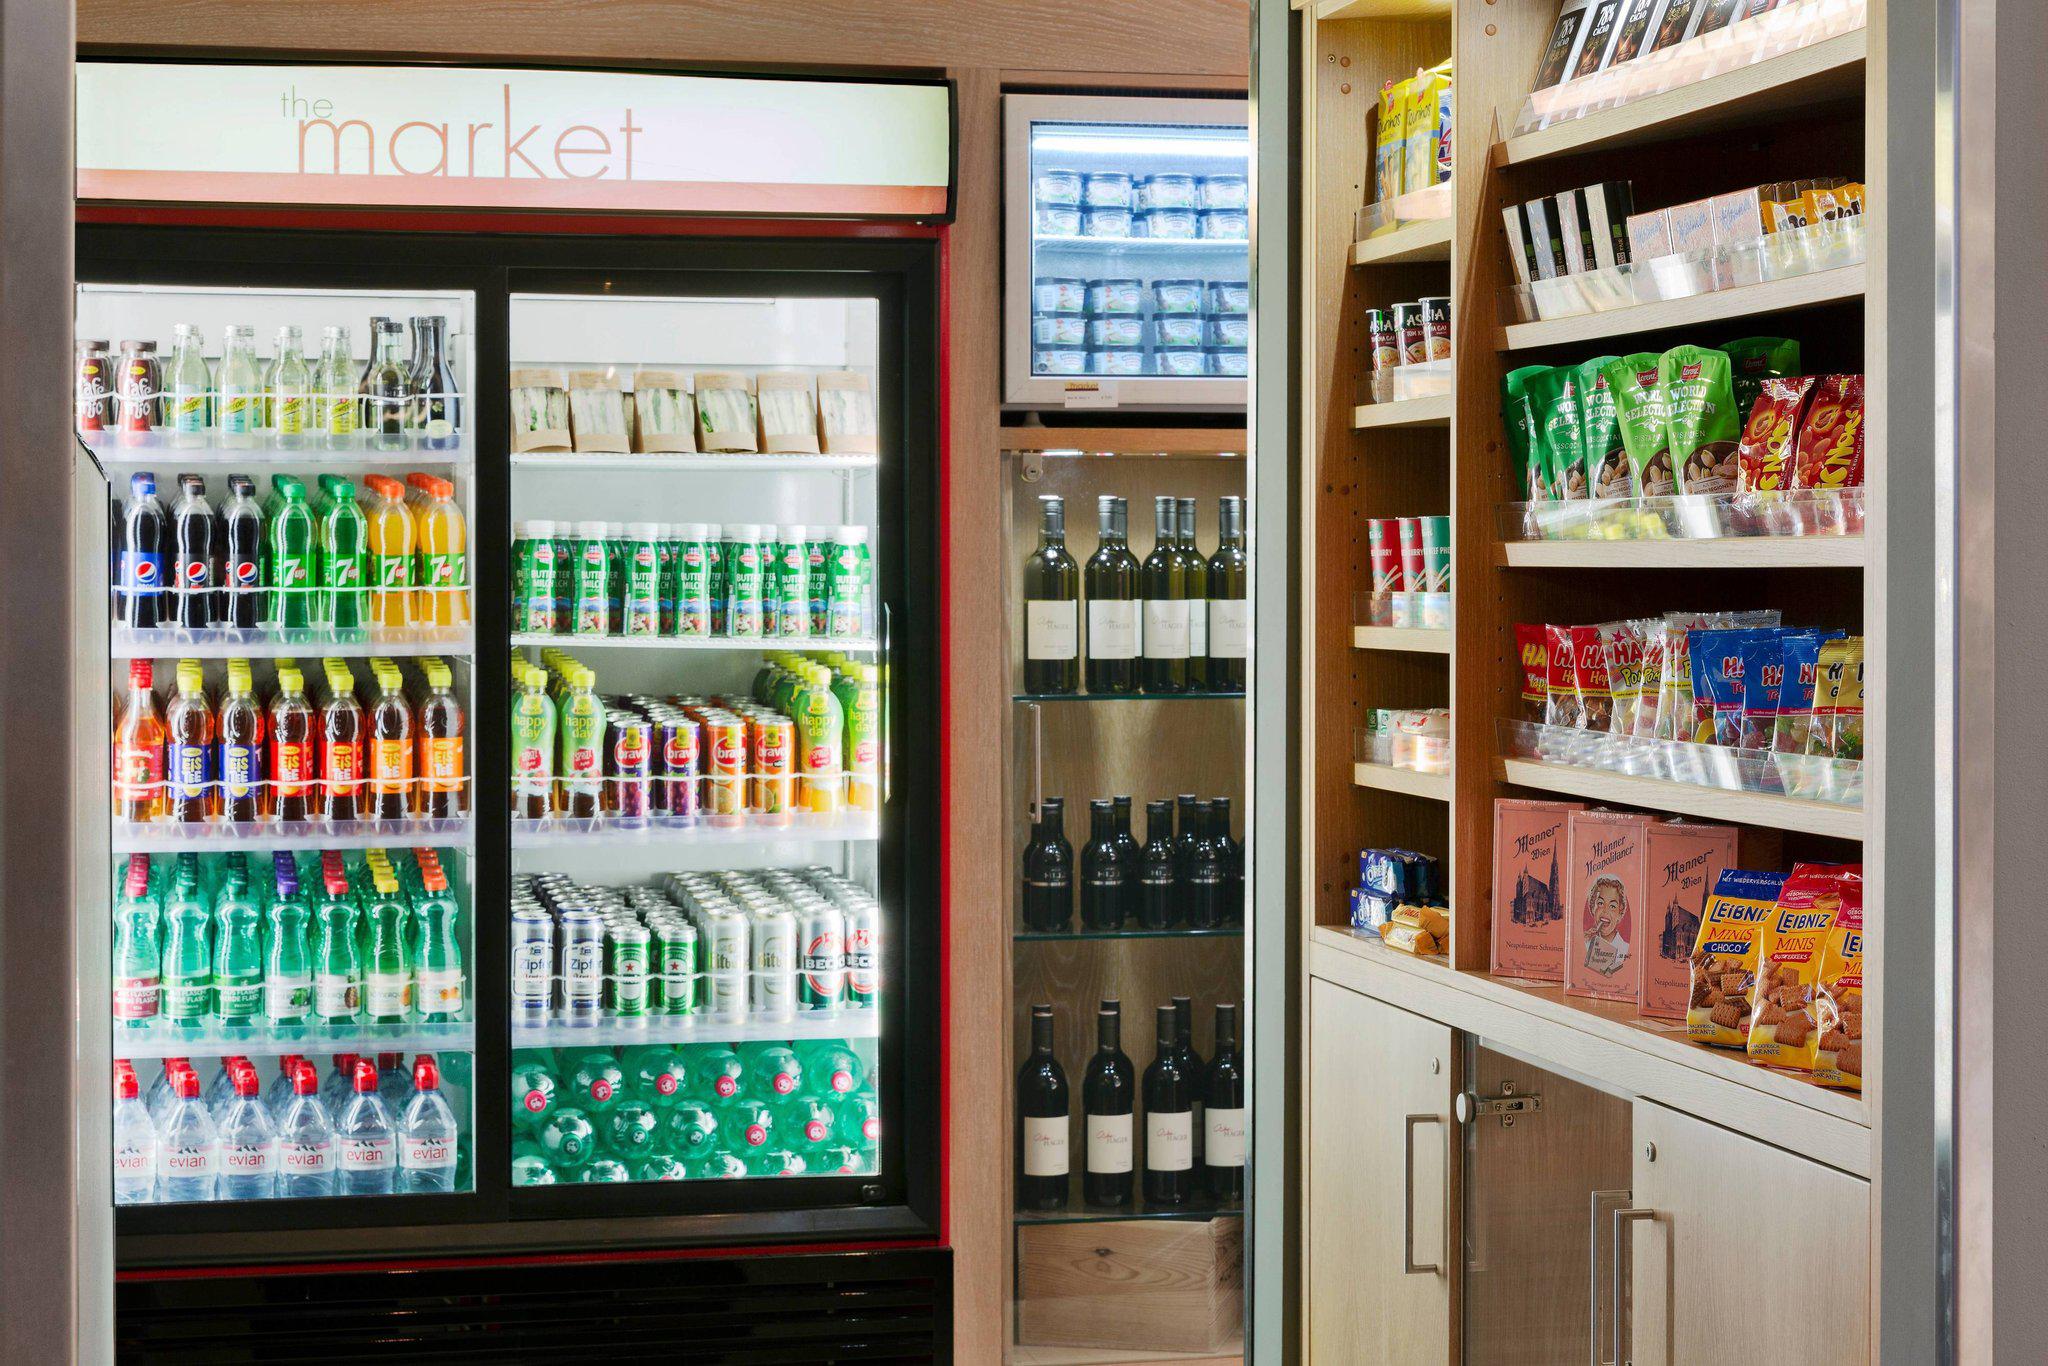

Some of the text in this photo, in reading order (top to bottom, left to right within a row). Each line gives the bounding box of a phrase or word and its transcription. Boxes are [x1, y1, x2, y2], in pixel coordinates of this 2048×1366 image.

[281, 85, 334, 119] the
[299, 83, 643, 181] market
[1585, 391, 1614, 407] WORL
[1669, 385, 1708, 401] WORLD
[1557, 401, 1578, 414] WOR
[1548, 413, 1580, 432] SELEC
[514, 713, 546, 730] happy
[565, 713, 599, 730] happy
[801, 712, 836, 729] happy
[519, 727, 541, 741] day
[571, 727, 593, 741] day
[808, 727, 831, 740] day
[1513, 822, 1562, 859] Manner
[1531, 846, 1551, 861] Wien
[1591, 835, 1627, 861] Manner
[1584, 843, 1635, 881] Neapolitaner
[1662, 849, 1714, 888] Manner
[1680, 876, 1702, 890] Wien
[1708, 899, 1773, 924] LEIBNIZ
[1776, 909, 1832, 934] LEIBNIZ
[1707, 927, 1755, 941] MINIS
[1505, 940, 1539, 953] Neapolitaner
[1711, 943, 1742, 954] CHOCO
[1776, 937, 1816, 951] MINIS
[1654, 977, 1688, 989] Neapolitane
[1839, 977, 1864, 985] BUTTER
[229, 1153, 265, 1167] evian
[287, 1152, 323, 1166] evian
[347, 1149, 382, 1162] evian
[413, 1147, 448, 1160] evian
[169, 1155, 206, 1168] evian
